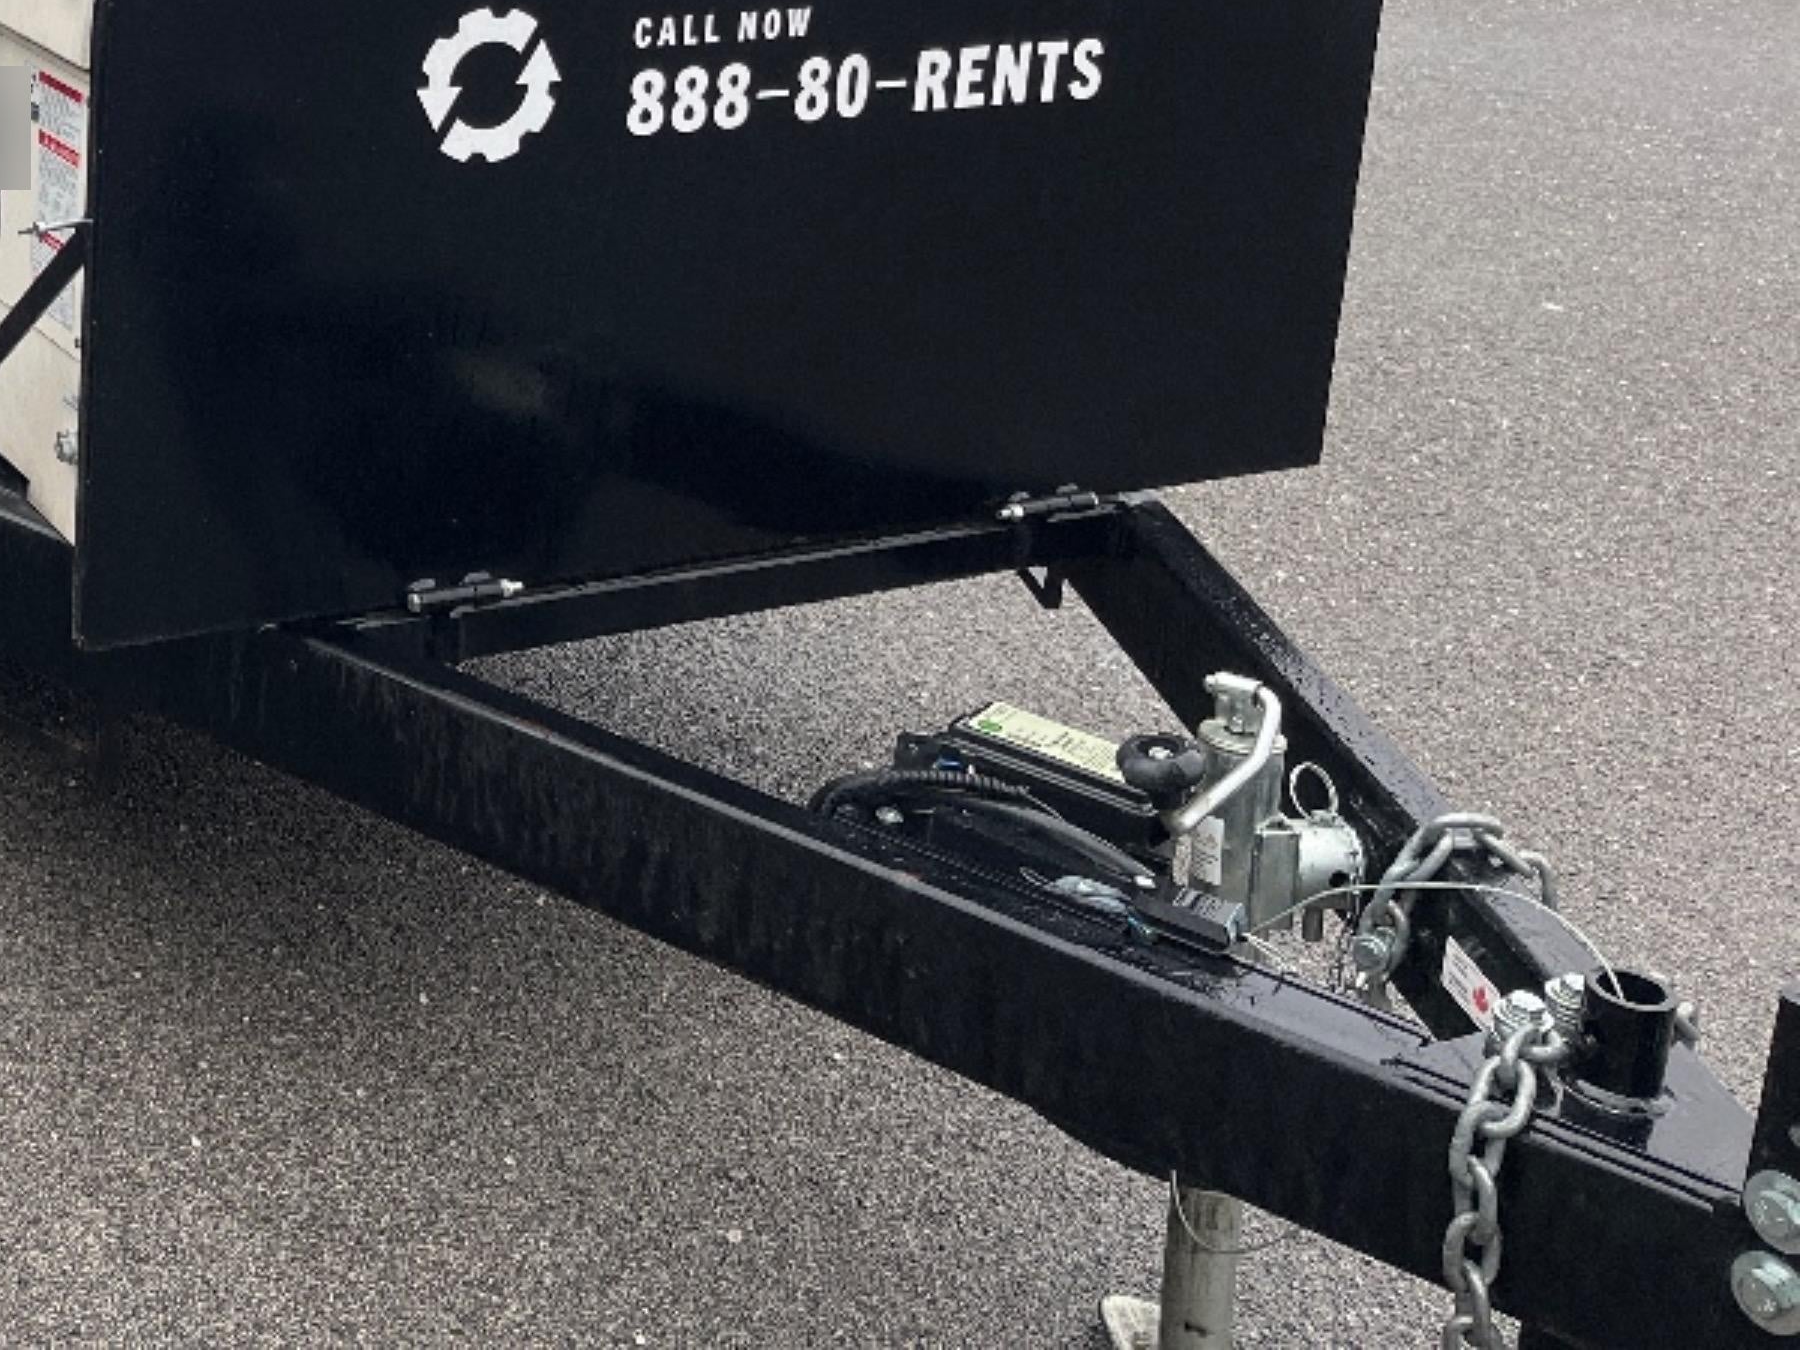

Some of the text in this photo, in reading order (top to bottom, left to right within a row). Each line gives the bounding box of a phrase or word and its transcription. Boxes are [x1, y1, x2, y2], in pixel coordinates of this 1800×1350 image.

[633, 5, 812, 49] CALL NOW
[625, 37, 1106, 137] 888-80-RENTS
